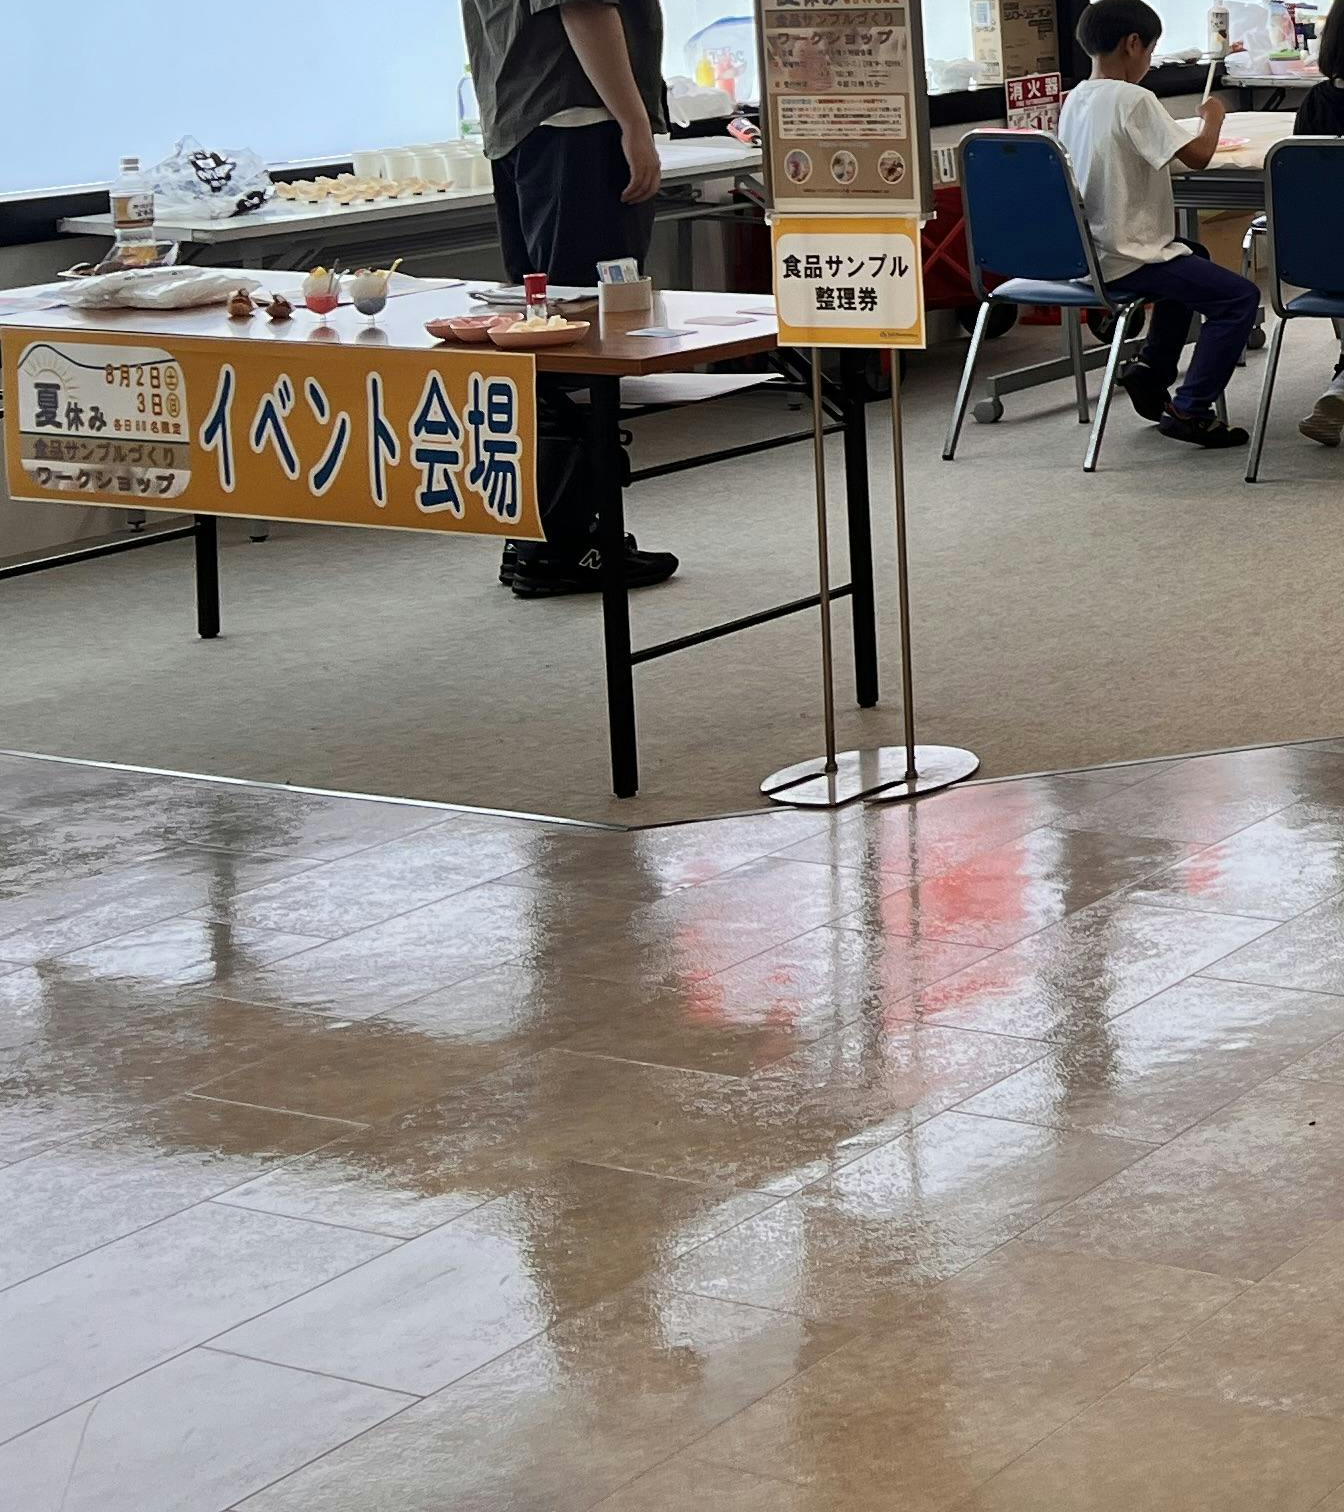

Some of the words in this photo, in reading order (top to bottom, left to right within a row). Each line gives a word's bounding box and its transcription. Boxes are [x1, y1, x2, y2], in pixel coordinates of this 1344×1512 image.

[777, 29, 894, 45] ワークショップ
[1008, 76, 1058, 101] 消火器
[782, 253, 909, 279] 食品サンプル
[815, 286, 878, 312] 整理券
[34, 382, 107, 432] 夏休み
[33, 438, 175, 468] 食品サンプルづくり
[201, 364, 522, 524] イベント会場
[35, 466, 175, 494] ワークショップ
